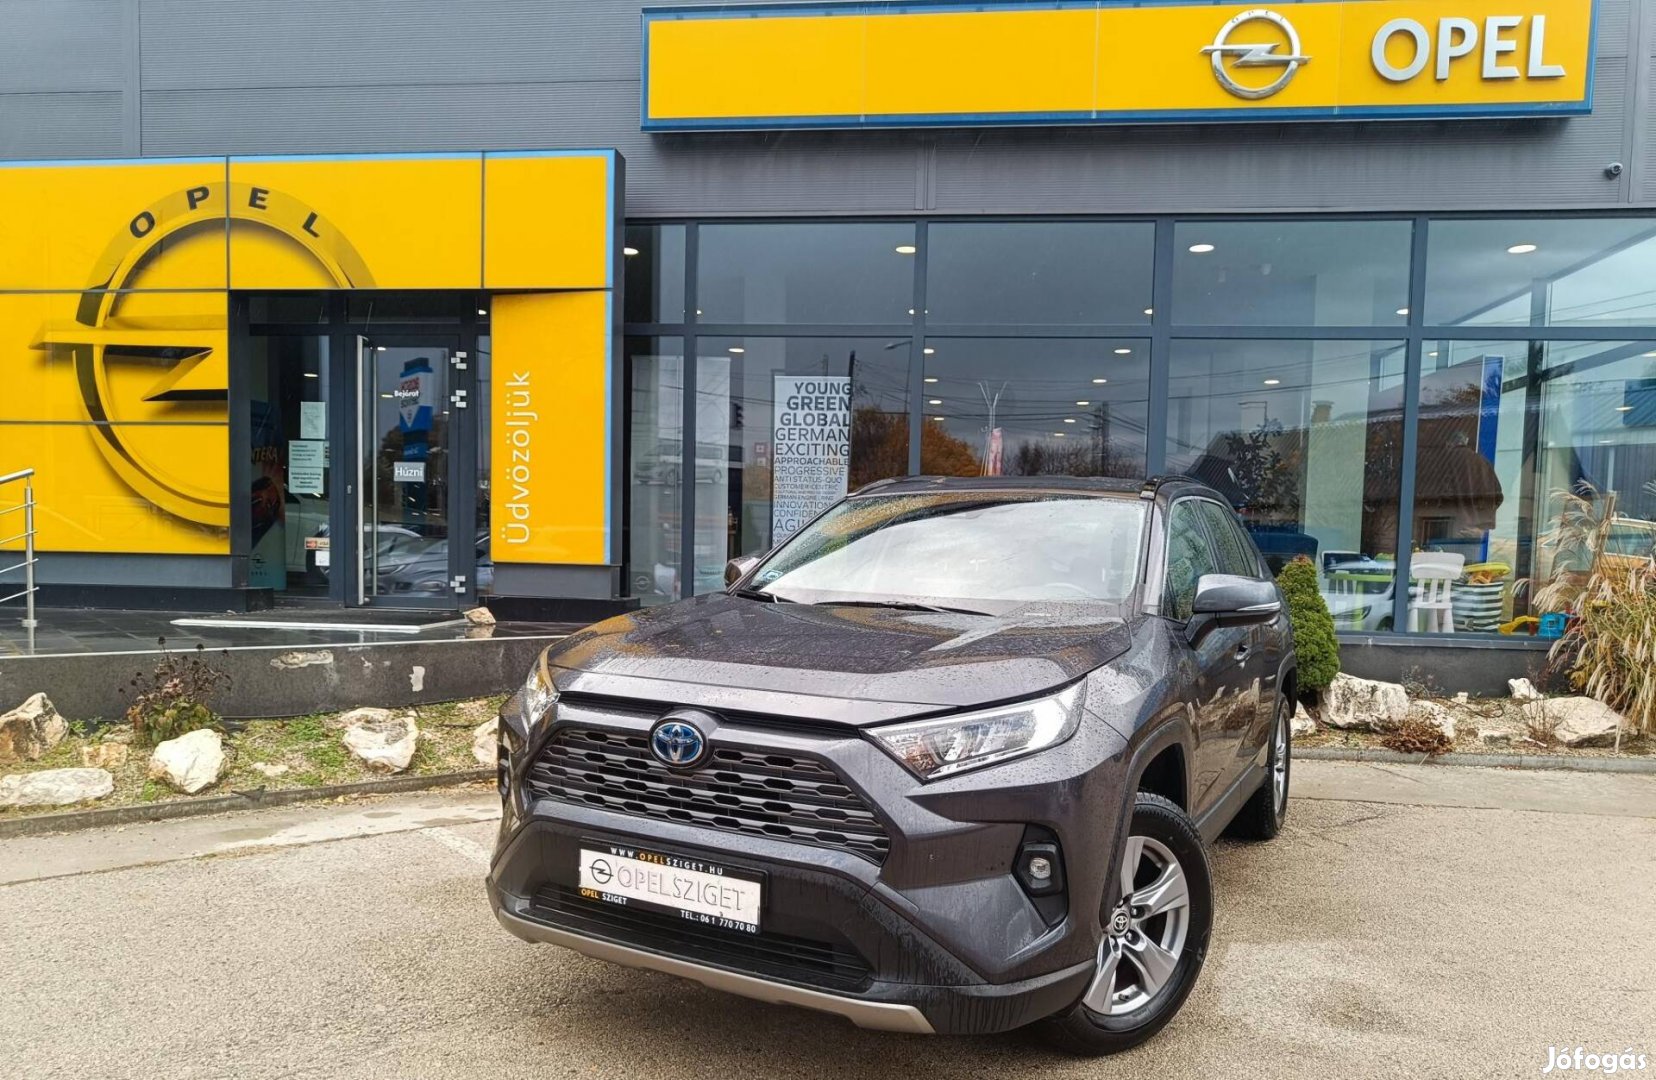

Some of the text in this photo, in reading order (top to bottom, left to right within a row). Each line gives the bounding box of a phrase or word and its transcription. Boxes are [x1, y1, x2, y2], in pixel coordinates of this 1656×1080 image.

[1371, 15, 1566, 82] OPEL
[129, 185, 320, 239] OPEL
[394, 389, 420, 399] Bejárat
[795, 382, 851, 395] YOUNG
[787, 396, 851, 411] GREEN
[780, 412, 850, 426] GLOBAL
[775, 427, 849, 442] GERMAN
[776, 443, 850, 456] EXCITING
[501, 370, 538, 544] Üdvözöljük
[774, 457, 849, 466] APPROACHABLE
[394, 466, 423, 478] Húzni
[774, 466, 845, 476] PROGRESSIVE
[610, 847, 723, 876] WWW.OPELSZIGET.HU
[581, 888, 627, 905] OPEL SZIGET
[680, 910, 698, 921] TEL.:
